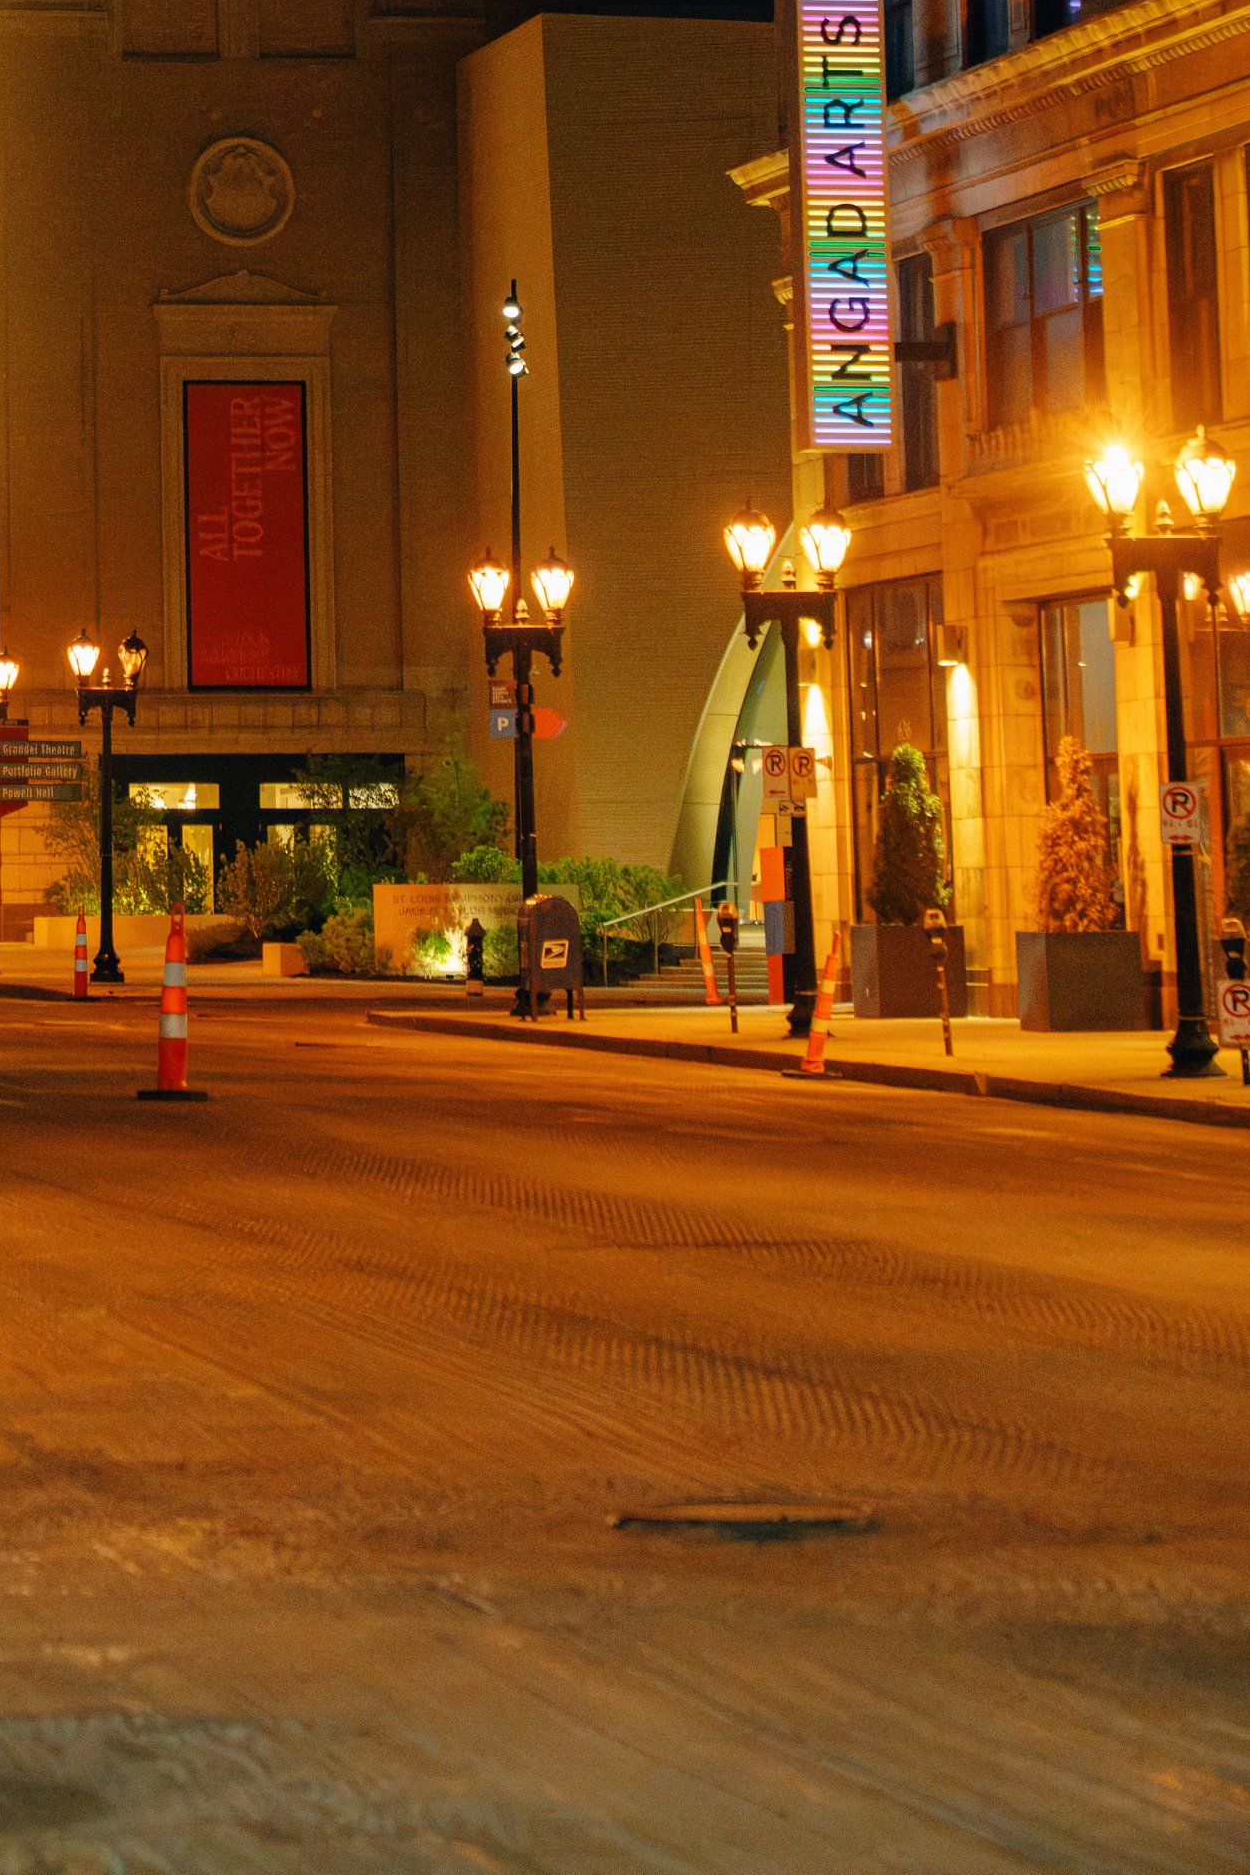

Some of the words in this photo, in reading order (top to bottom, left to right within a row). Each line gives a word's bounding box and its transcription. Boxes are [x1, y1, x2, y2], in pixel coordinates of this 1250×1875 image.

[820, 14, 867, 179] ARTS
[826, 204, 874, 428] ANGAD
[263, 394, 296, 471] NOW
[230, 397, 264, 563] TOGETHER
[197, 506, 229, 562] ALL
[41, 744, 75, 755] Theatre
[498, 716, 510, 731] P
[2, 765, 42, 777] Portfolio
[45, 765, 78, 779] Gallery
[2, 787, 33, 798] Powell
[36, 786, 54, 798] Hall
